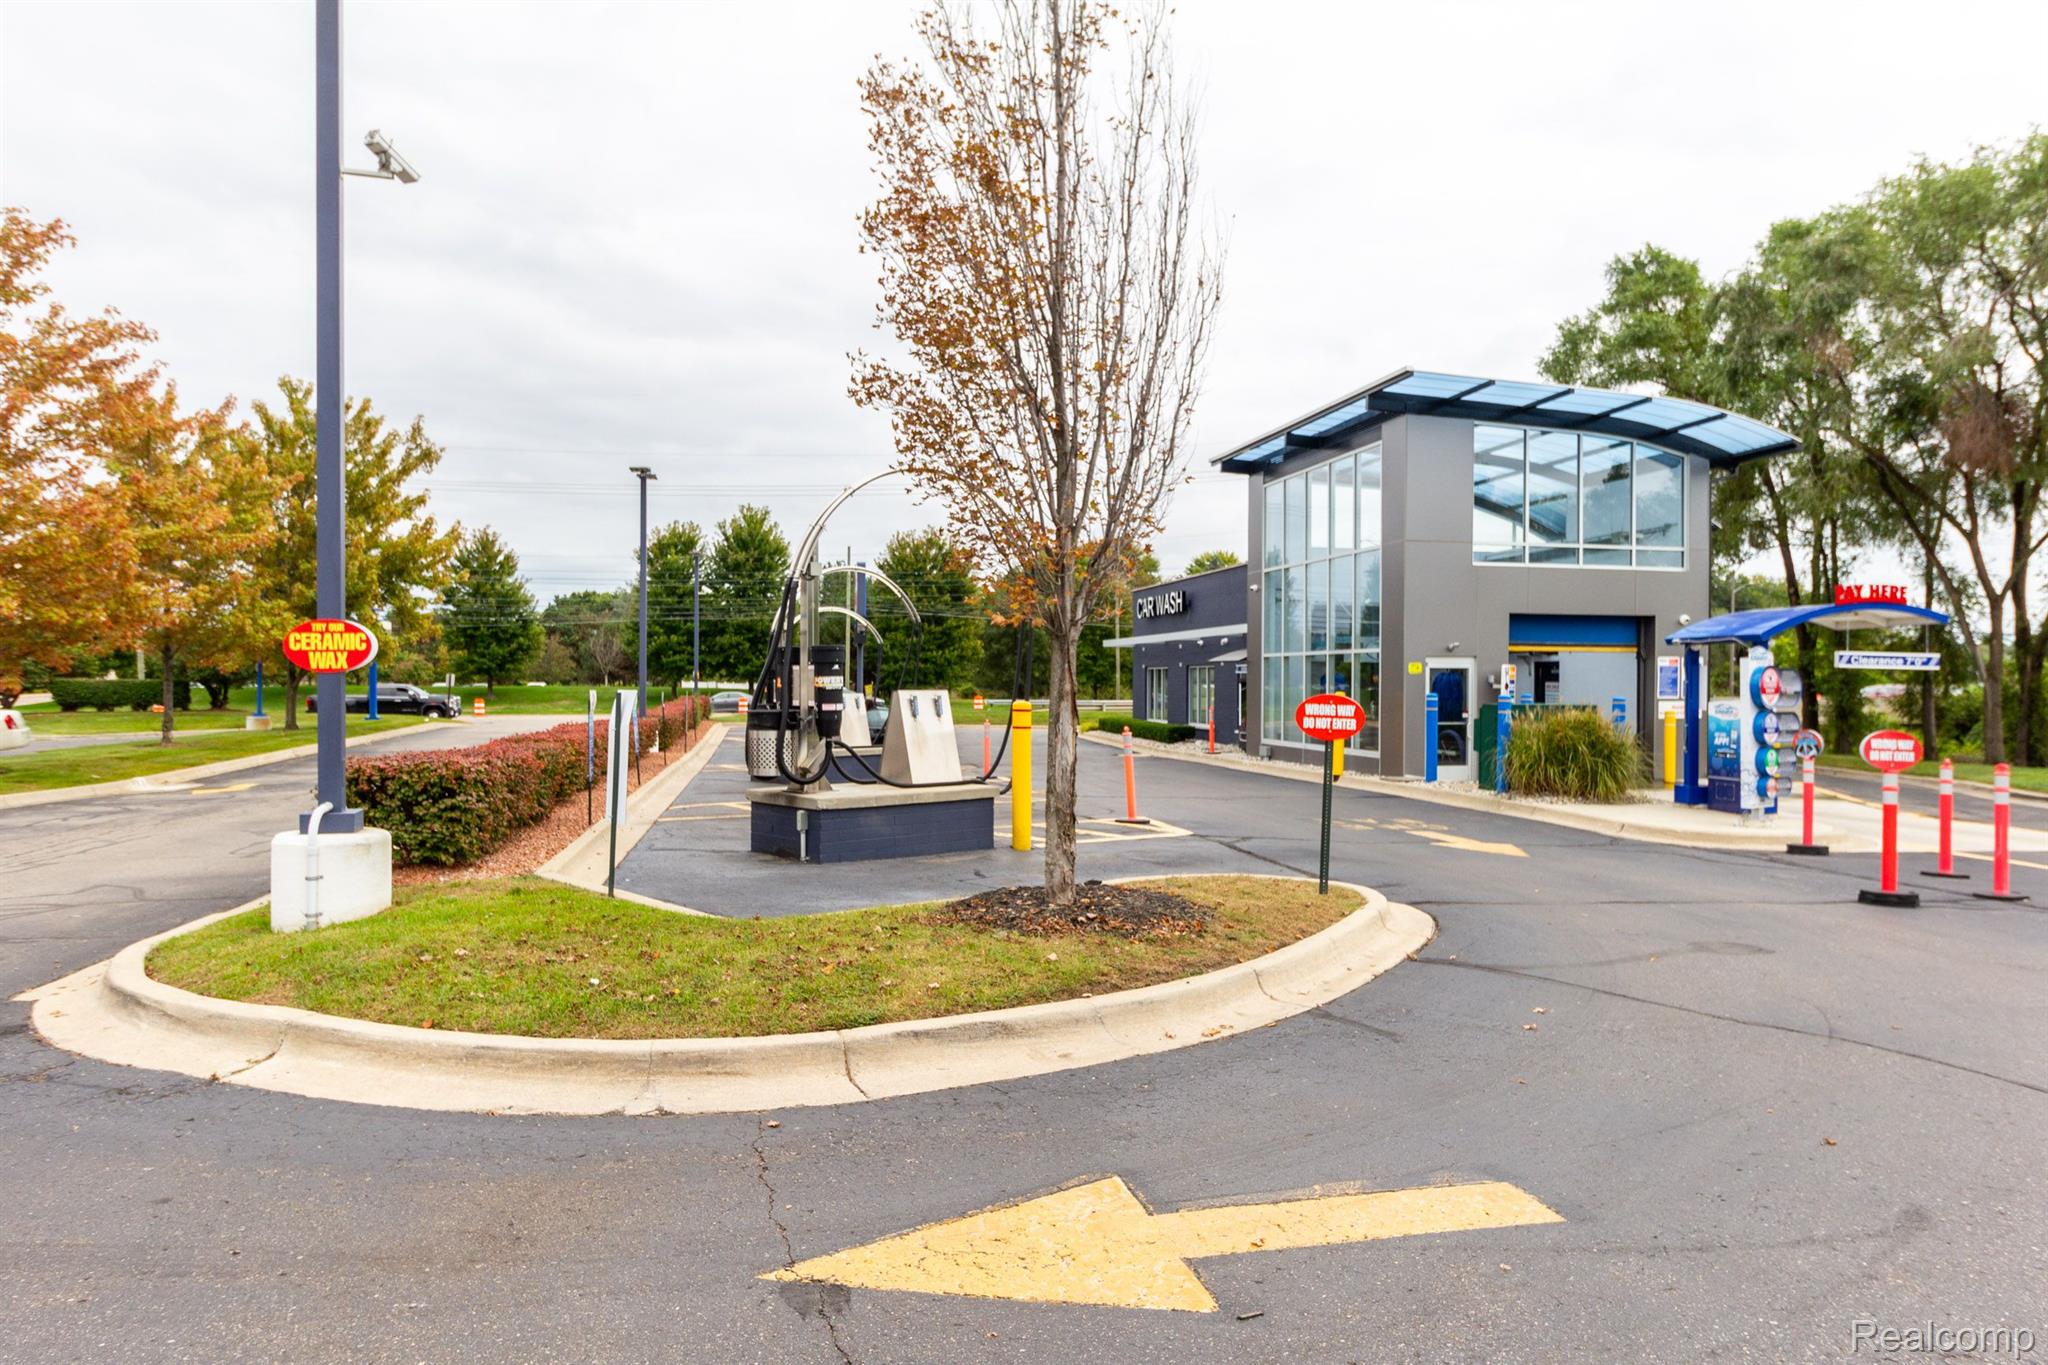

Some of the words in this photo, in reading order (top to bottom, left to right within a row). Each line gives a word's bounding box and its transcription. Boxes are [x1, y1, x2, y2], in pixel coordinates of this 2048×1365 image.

[1835, 584, 1863, 601] PAY
[1869, 585, 1907, 601] HERE
[1136, 596, 1155, 619] CAR
[1155, 590, 1183, 616] WASH
[311, 623, 326, 632] TRY
[328, 623, 345, 632] OUR
[288, 632, 367, 651] CERAMIC
[308, 651, 348, 669] WAX
[1850, 655, 1905, 666] Clearance
[1305, 703, 1336, 716] WRONG
[1337, 704, 1356, 717] WAY
[1303, 717, 1315, 729] DO
[1315, 717, 1332, 730] NOT
[1332, 718, 1357, 731] ENTER
